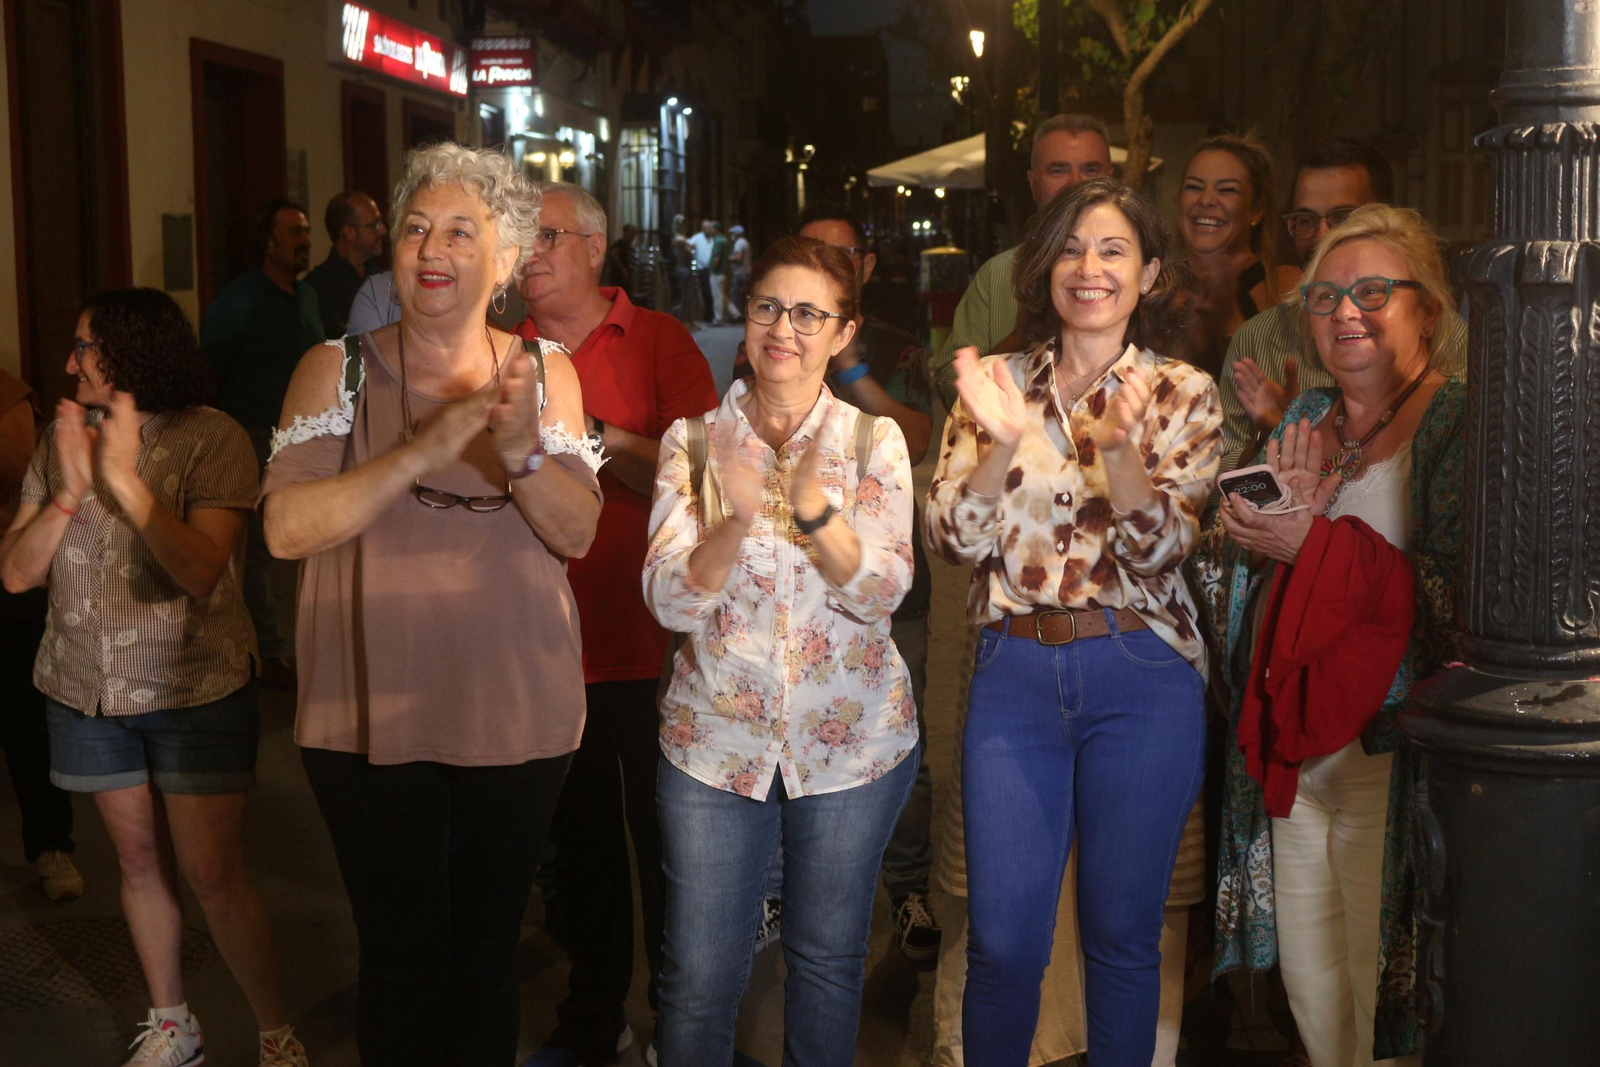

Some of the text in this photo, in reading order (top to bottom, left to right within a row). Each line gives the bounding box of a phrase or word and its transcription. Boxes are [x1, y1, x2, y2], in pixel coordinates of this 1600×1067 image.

[472, 65, 532, 84] LA PARADA
[1234, 482, 1267, 494] 22:00
